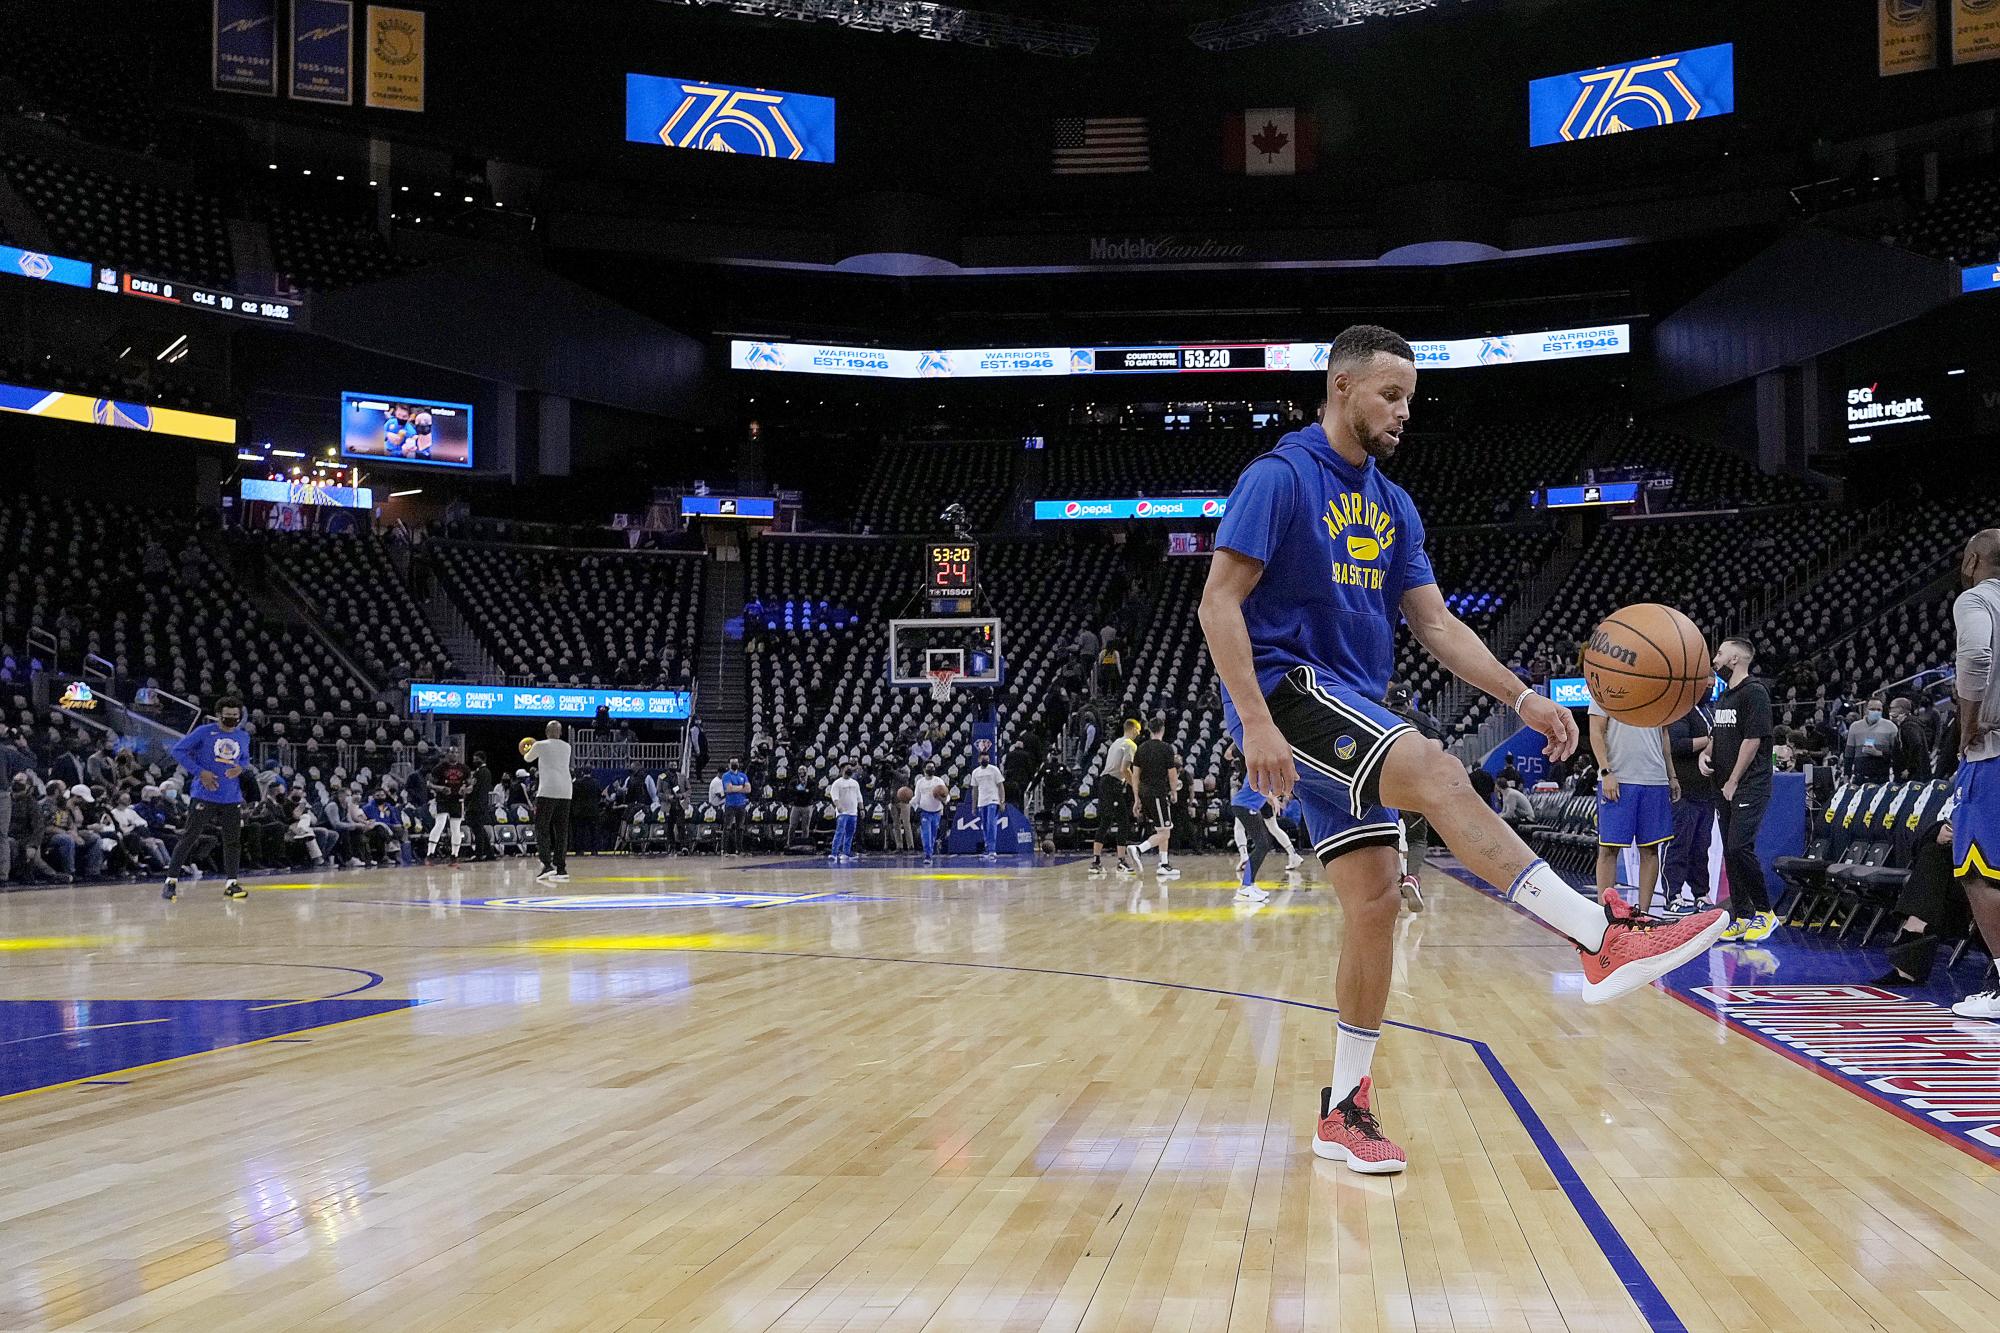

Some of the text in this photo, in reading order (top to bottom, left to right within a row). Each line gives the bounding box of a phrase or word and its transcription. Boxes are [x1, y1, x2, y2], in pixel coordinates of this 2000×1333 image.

[1089, 237, 1155, 260] Modelo
[131, 279, 158, 294] DEN
[193, 291, 215, 305] CLE
[241, 301, 258, 313] Q2
[1547, 329, 1615, 342] WARRIORS
[1409, 344, 1447, 352] RIORS
[818, 349, 885, 360] WARRIORS
[985, 351, 1050, 360] WARRIORS
[1126, 352, 1176, 360] COUNTDOWN
[1184, 349, 1230, 368] 53:20
[1136, 359, 1158, 367] GAME
[1847, 387, 1873, 404] 5G
[1847, 397, 1923, 421] built right
[1081, 504, 1113, 516] pepsi
[1152, 503, 1184, 515] pepsi
[933, 548, 970, 562] 53:20
[936, 562, 967, 585] 24
[418, 690, 447, 703] NBC
[465, 692, 496, 702] CHANNEL
[1555, 684, 1582, 697] NBC
[465, 700, 487, 709] CABLE
[514, 694, 541, 705] NBC
[559, 695, 588, 704] CHANNEL
[605, 696, 632, 707] NBC
[649, 697, 677, 706] CHANNEL
[559, 703, 579, 711] CABLE
[649, 705, 668, 713] CABLE
[1517, 756, 1543, 773] PS5
[957, 816, 1009, 830] KA
